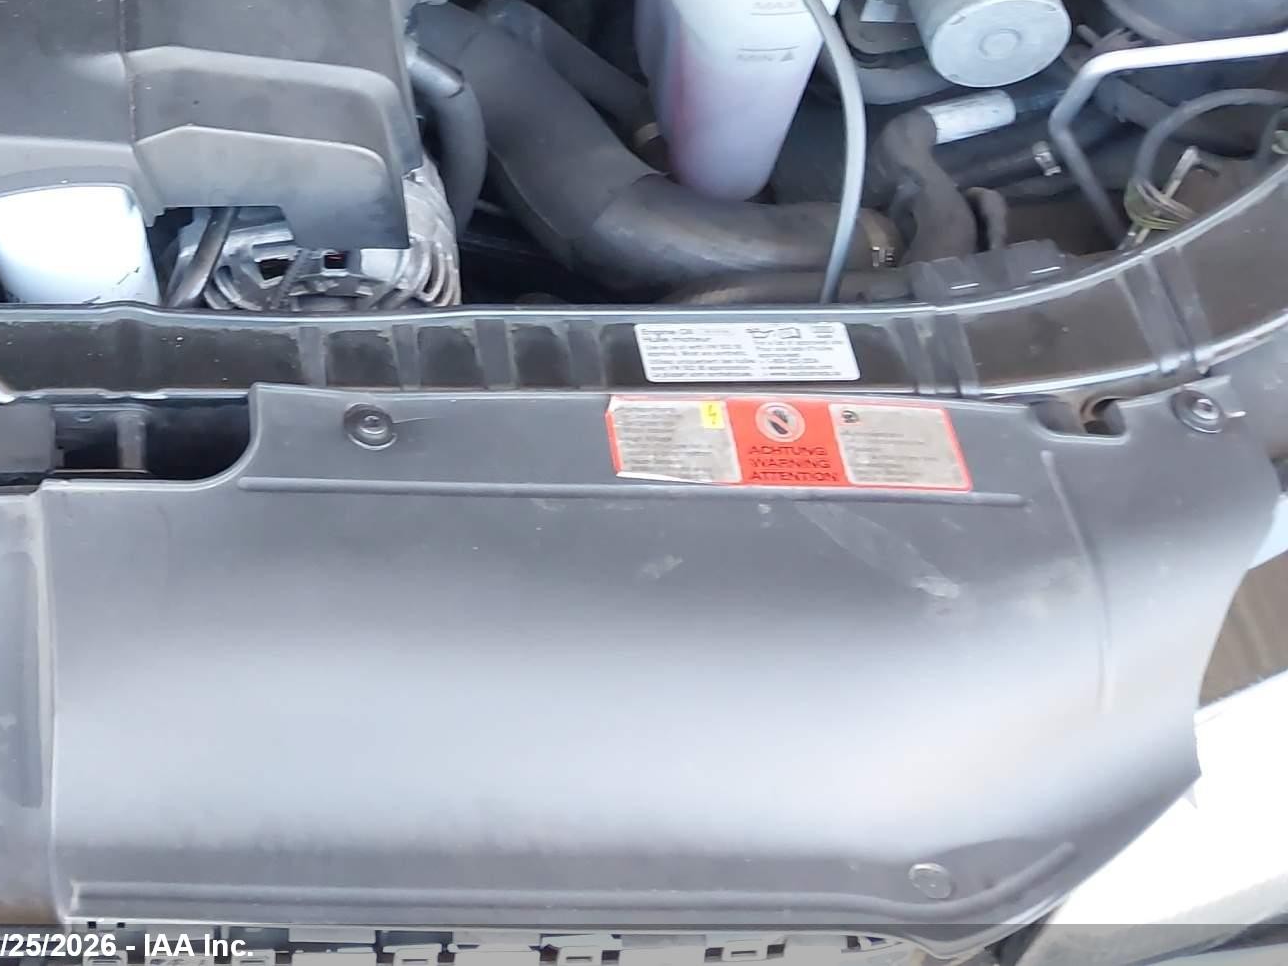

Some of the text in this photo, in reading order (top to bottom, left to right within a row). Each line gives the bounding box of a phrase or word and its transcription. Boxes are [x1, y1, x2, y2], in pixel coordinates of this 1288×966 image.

[748, 445, 828, 456] ACHTUNG
[749, 458, 831, 469] WARNING
[749, 471, 840, 482] ATTENTION
